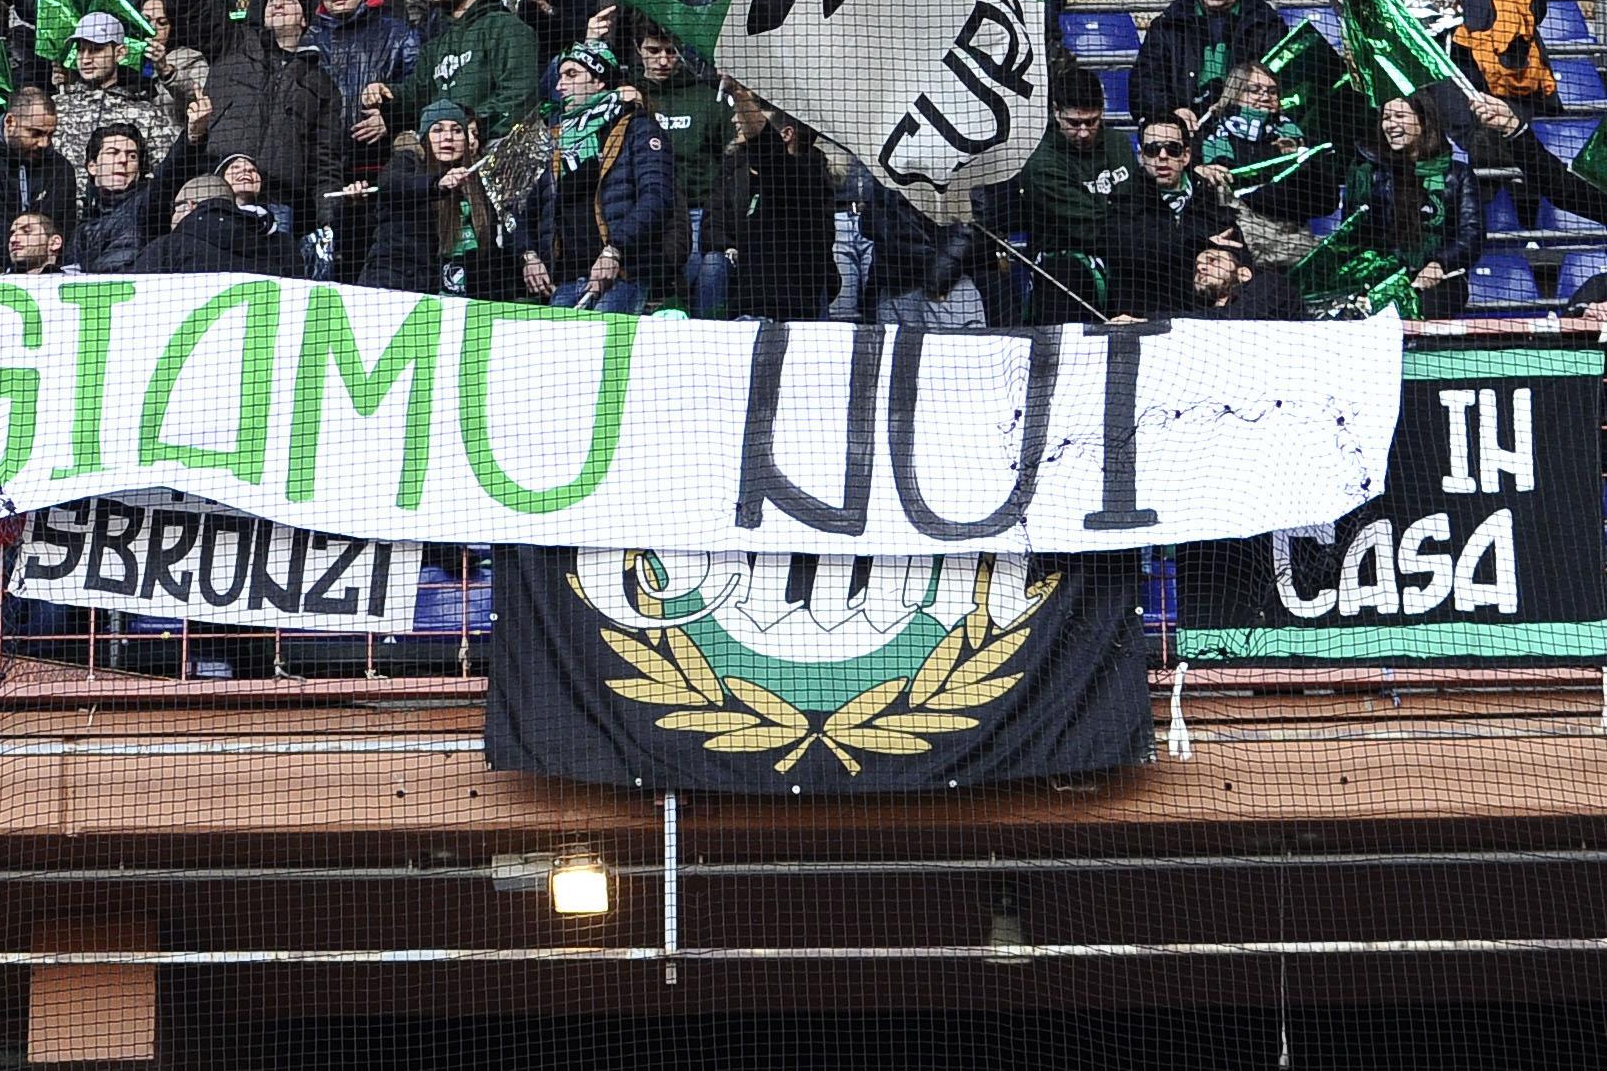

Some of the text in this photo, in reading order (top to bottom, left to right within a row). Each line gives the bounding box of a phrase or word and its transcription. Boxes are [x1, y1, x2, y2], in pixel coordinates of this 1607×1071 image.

[734, 317, 1173, 542] NOI
[24, 495, 393, 619] SBRONZI
[1271, 507, 1518, 619] CASA
